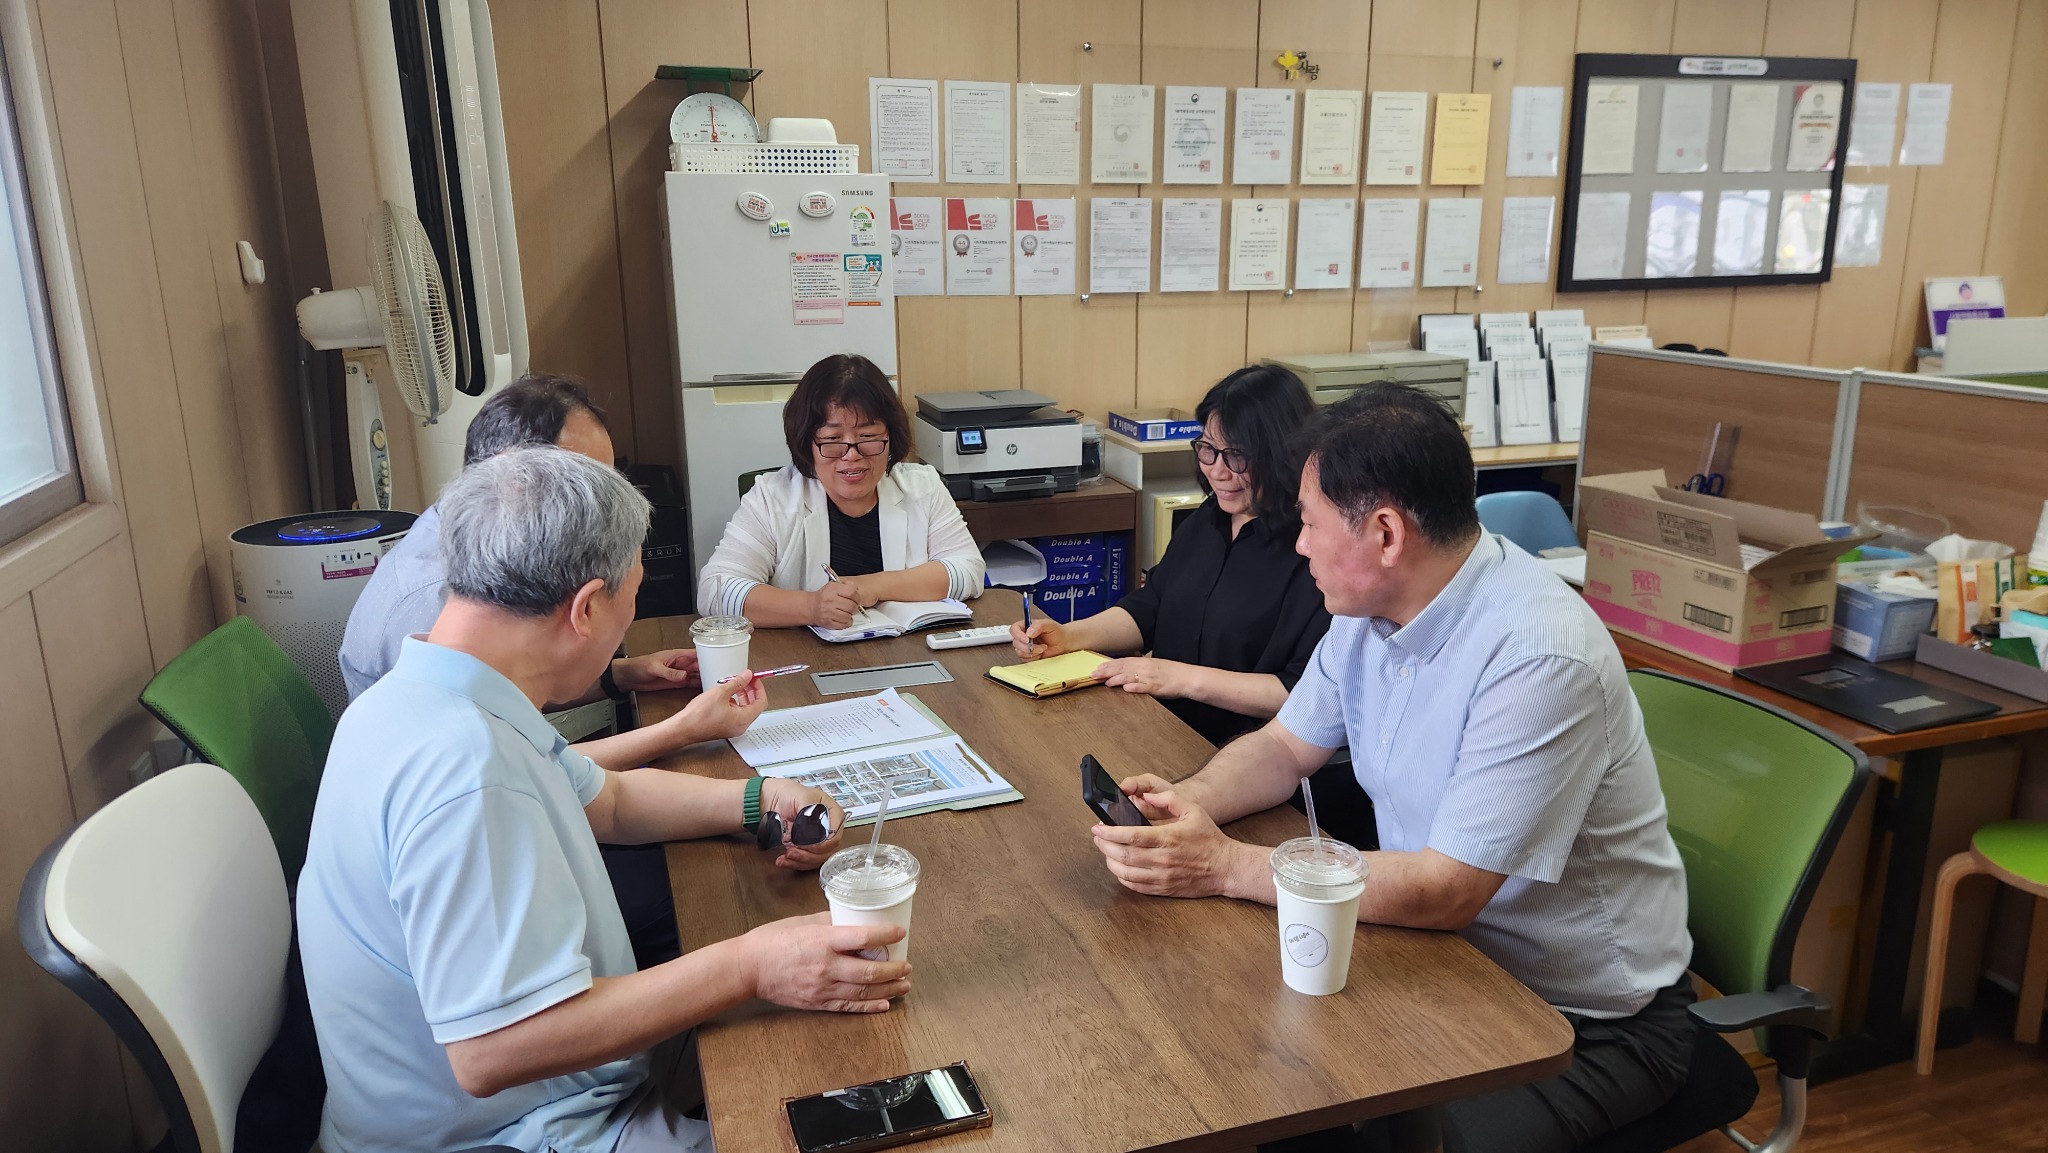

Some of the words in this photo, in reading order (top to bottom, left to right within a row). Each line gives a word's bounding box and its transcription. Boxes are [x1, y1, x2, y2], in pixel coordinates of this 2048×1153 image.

[1298, 60, 1320, 80] 사랑
[1113, 418, 1118, 428] A
[1118, 420, 1138, 436] Double
[1007, 444, 1017, 455] hp
[656, 547, 681, 556] RUN
[1054, 555, 1083, 563] Double
[1050, 572, 1080, 581] Double
[1044, 588, 1084, 601] Double
[1088, 586, 1096, 596] A
